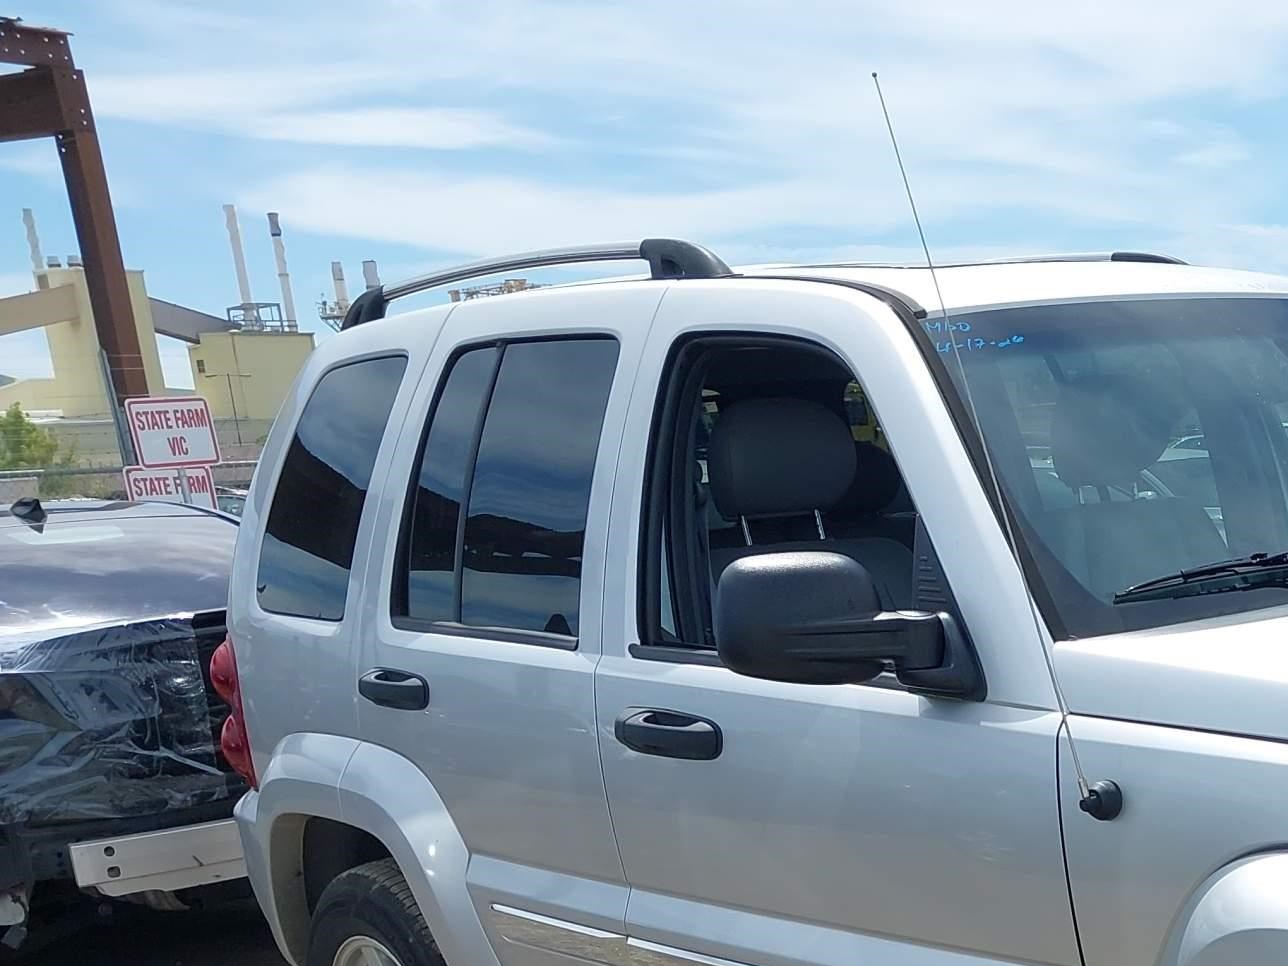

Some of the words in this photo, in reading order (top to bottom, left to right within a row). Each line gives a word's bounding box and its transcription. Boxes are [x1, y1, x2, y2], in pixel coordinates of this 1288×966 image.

[135, 410, 173, 431] STATE
[173, 408, 208, 428] FARM
[167, 436, 189, 456] VIC
[133, 477, 173, 497] STATE
[173, 475, 209, 495] FRM
